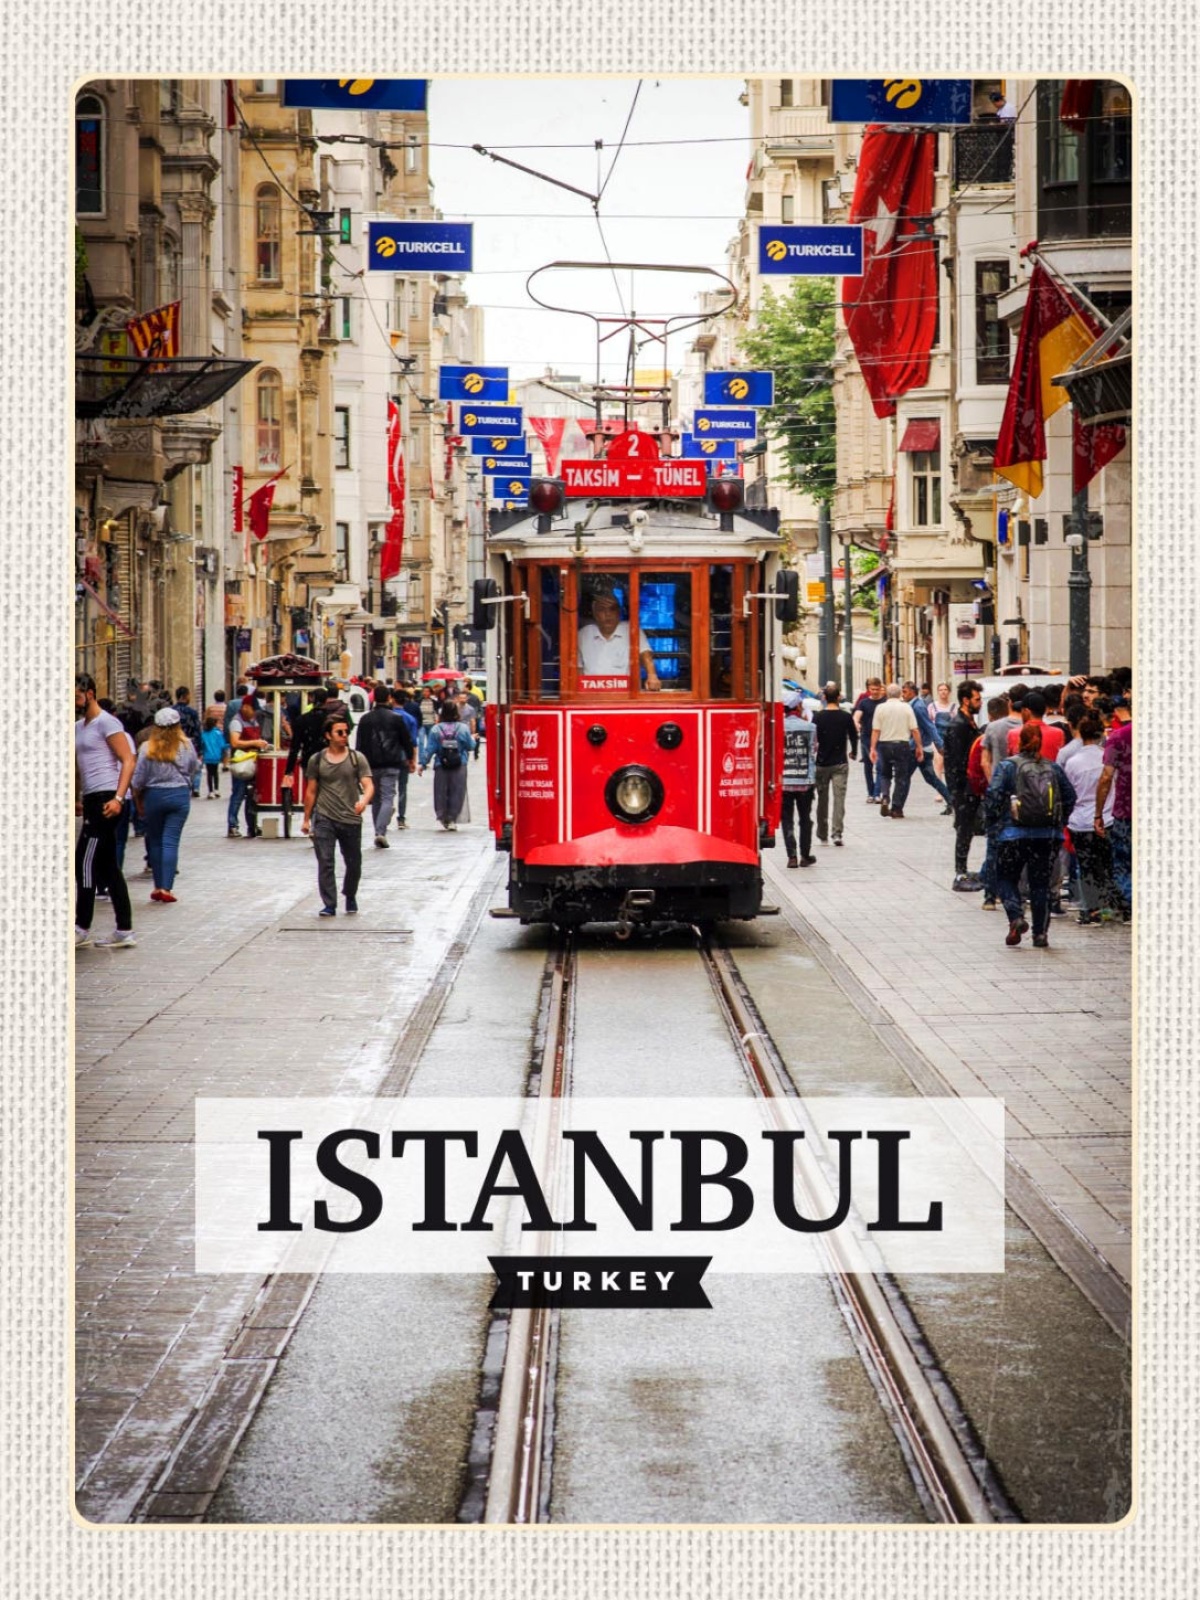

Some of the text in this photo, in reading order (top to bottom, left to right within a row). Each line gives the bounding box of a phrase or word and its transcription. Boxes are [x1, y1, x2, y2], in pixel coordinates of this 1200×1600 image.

[397, 241, 465, 254] TURKCELL
[788, 244, 855, 256] TURKCELL
[477, 416, 518, 425] TURKCELL
[711, 421, 752, 429] TURKCELL
[628, 434, 639, 457] 2
[496, 460, 529, 468] TURKCELL
[566, 464, 620, 487] TAKSİM
[654, 462, 702, 486] TÜNEL
[581, 678, 628, 689] TAKSİM
[522, 730, 538, 749] 223
[734, 730, 750, 748] 223
